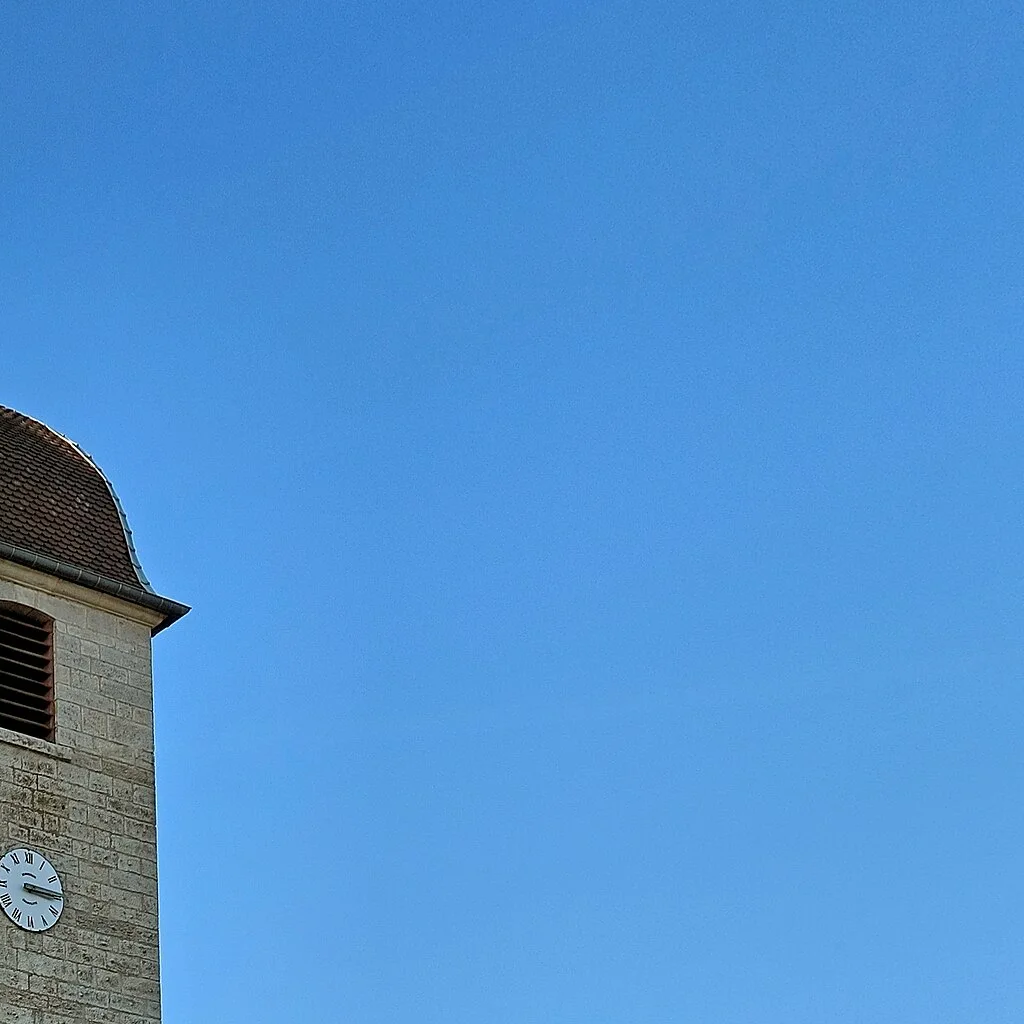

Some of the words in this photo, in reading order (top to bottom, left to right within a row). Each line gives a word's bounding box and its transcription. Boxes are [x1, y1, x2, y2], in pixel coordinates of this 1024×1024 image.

[10, 852, 20, 865] XI
[24, 852, 34, 864] XII
[0, 863, 10, 874] X
[39, 861, 45, 870] I
[48, 875, 57, 884] II
[0, 893, 12, 908] VIII
[11, 907, 22, 922] VII
[41, 915, 48, 926] V
[27, 915, 34, 928] VI
